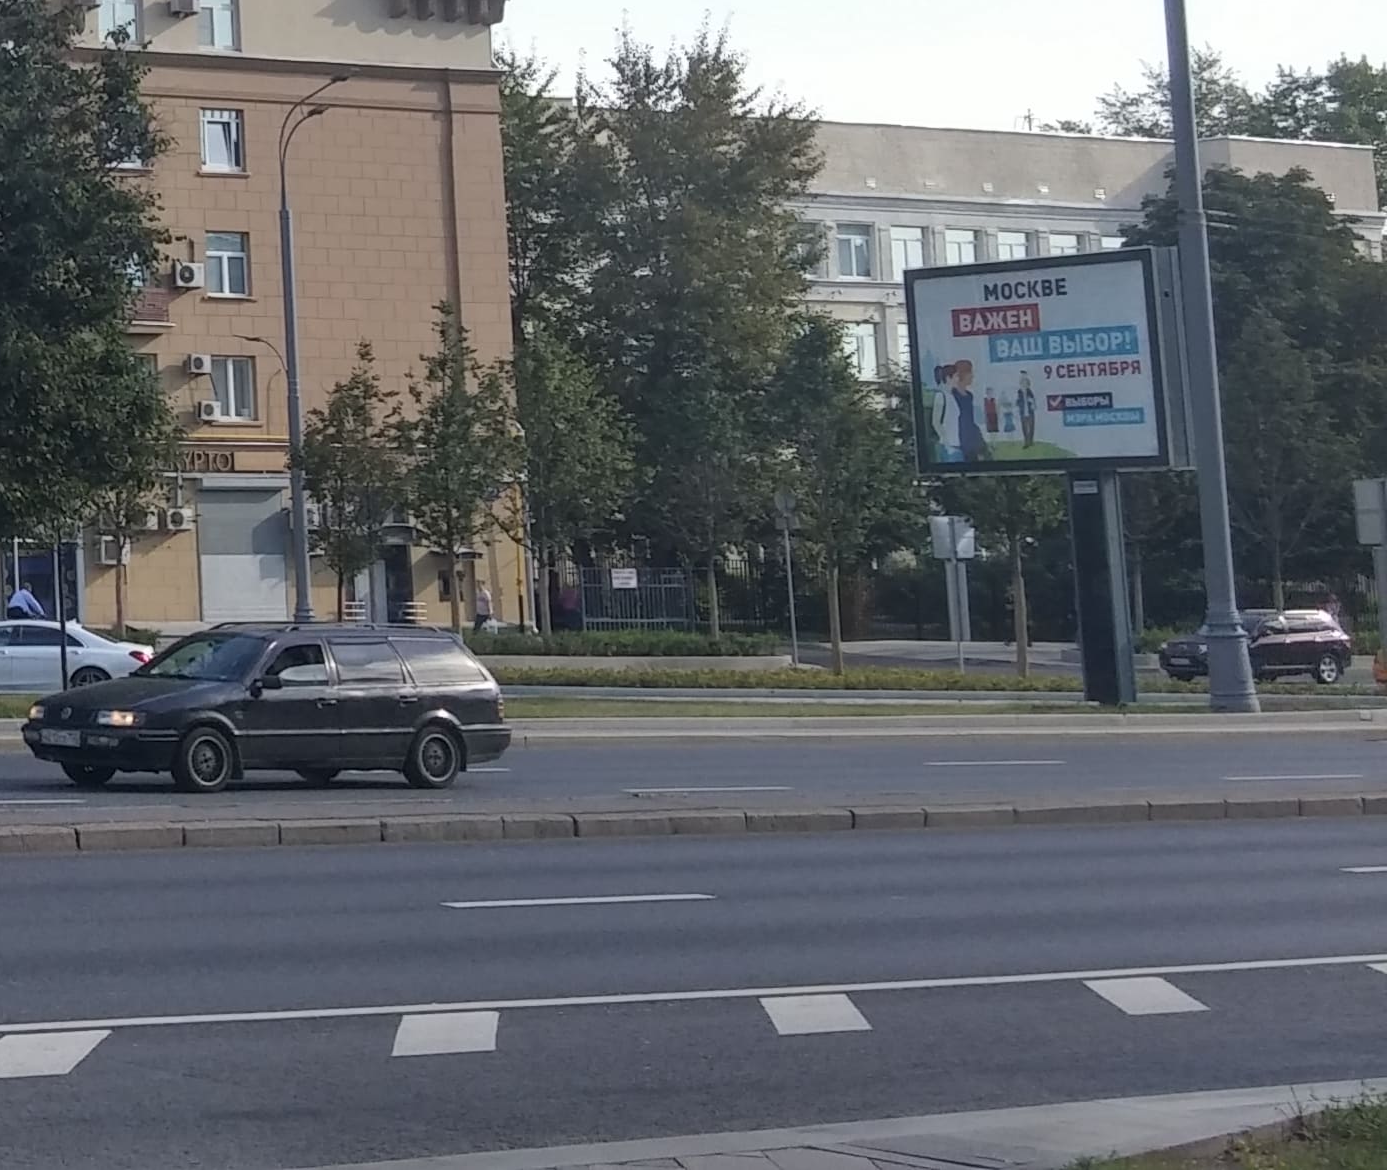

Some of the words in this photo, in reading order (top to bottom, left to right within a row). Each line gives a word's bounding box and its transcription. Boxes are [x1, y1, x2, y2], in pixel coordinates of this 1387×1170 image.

[983, 277, 1068, 301] МОСКВЕ
[958, 308, 1033, 332] ВАЖЕН
[995, 336, 1044, 358] ВАШ
[1048, 330, 1131, 354] ВЫБОР!
[1043, 365, 1053, 379] 9
[1056, 360, 1142, 379] СЕНТЯБРЯ
[1065, 395, 1110, 407] ВЫБОРЫ
